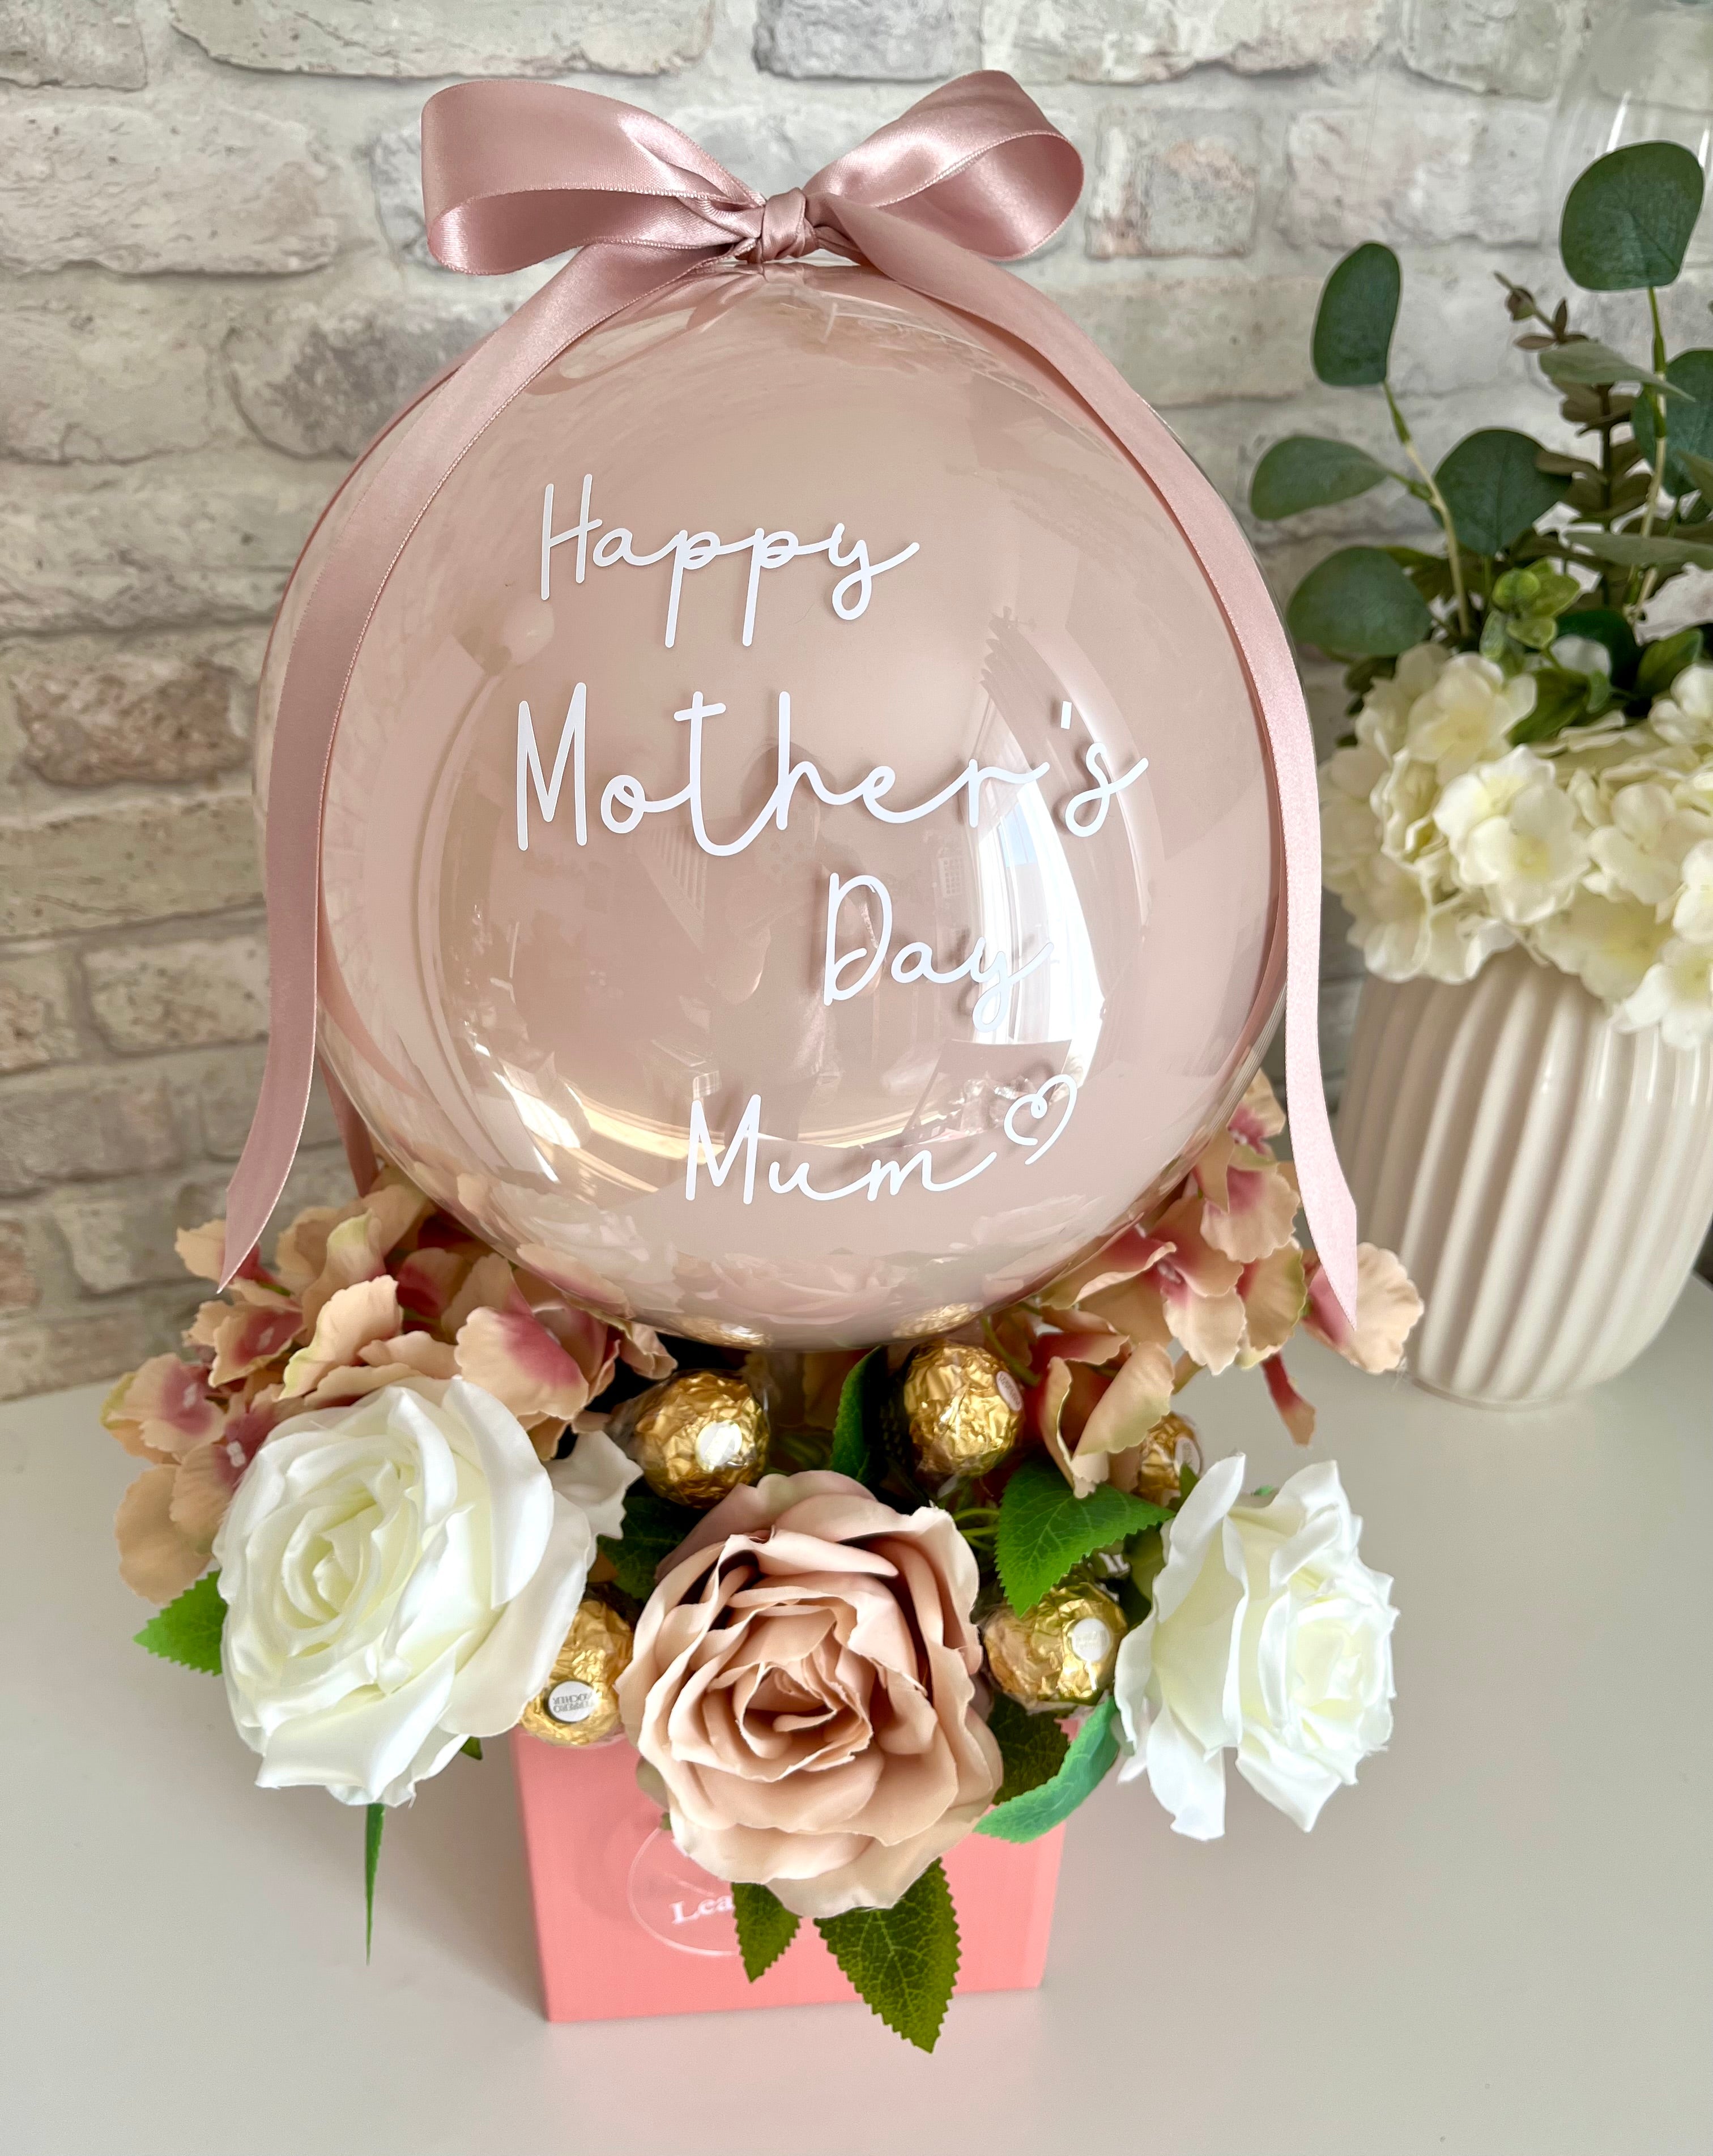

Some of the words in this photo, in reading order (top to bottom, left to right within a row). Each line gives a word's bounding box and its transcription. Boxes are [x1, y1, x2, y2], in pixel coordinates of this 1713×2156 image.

[541, 474, 920, 648] Happy
[517, 682, 1149, 857] Mother's
[823, 872, 1054, 1033] Day
[685, 1094, 998, 1204] Mum
